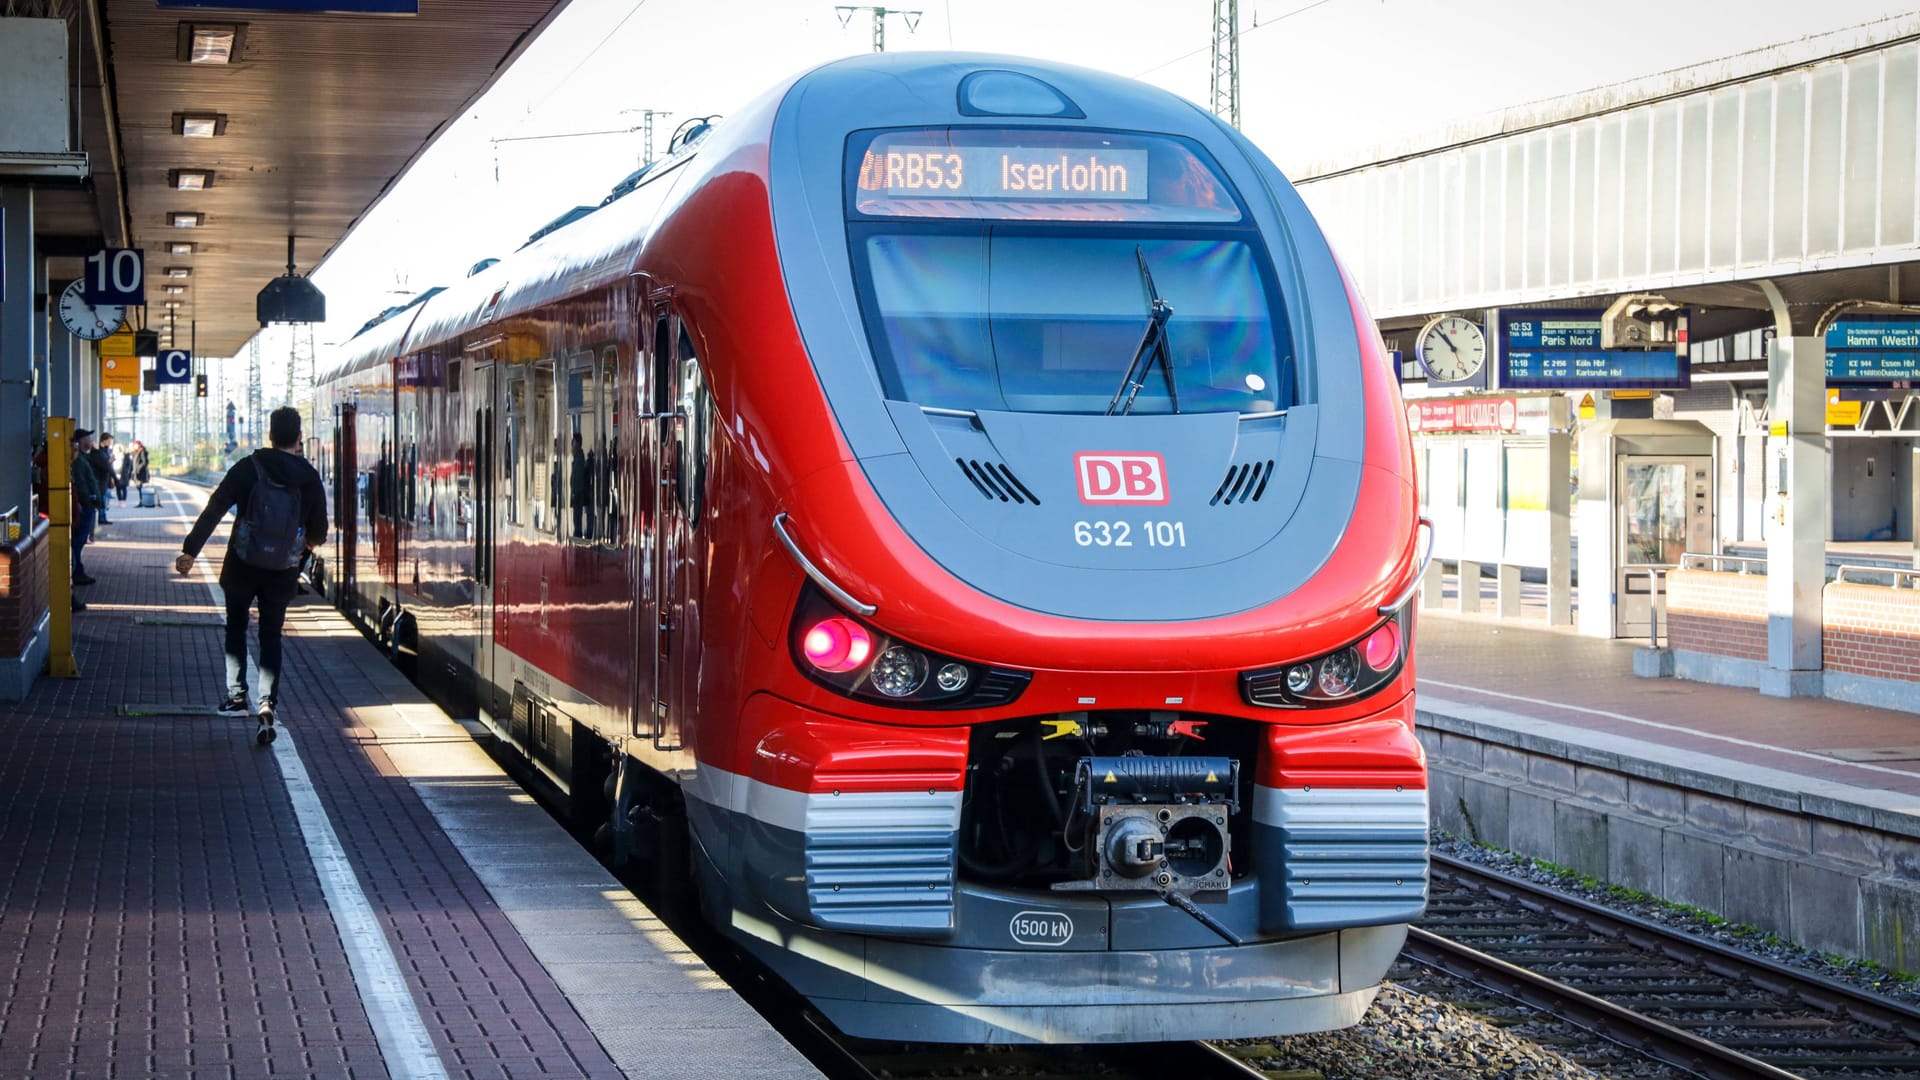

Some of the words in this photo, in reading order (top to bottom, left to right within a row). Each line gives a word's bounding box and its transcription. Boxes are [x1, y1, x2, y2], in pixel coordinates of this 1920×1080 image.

[888, 153, 962, 189] RB53
[1003, 154, 1127, 191] Iserlohn
[88, 250, 141, 292] 10
[1509, 323, 1532, 331] 10:53
[1541, 336, 1566, 346] Paris
[1570, 336, 1592, 346] Nord
[1847, 336, 1878, 346] Hamm
[166, 351, 186, 378] C
[1576, 359, 1591, 367] Köln
[1456, 403, 1498, 427] WILLKOMMEN
[1086, 460, 1156, 496] DB
[1074, 520, 1133, 546] 632
[1143, 521, 1186, 547] 101
[1014, 920, 1048, 936] 1500
[1051, 920, 1068, 938] kN
